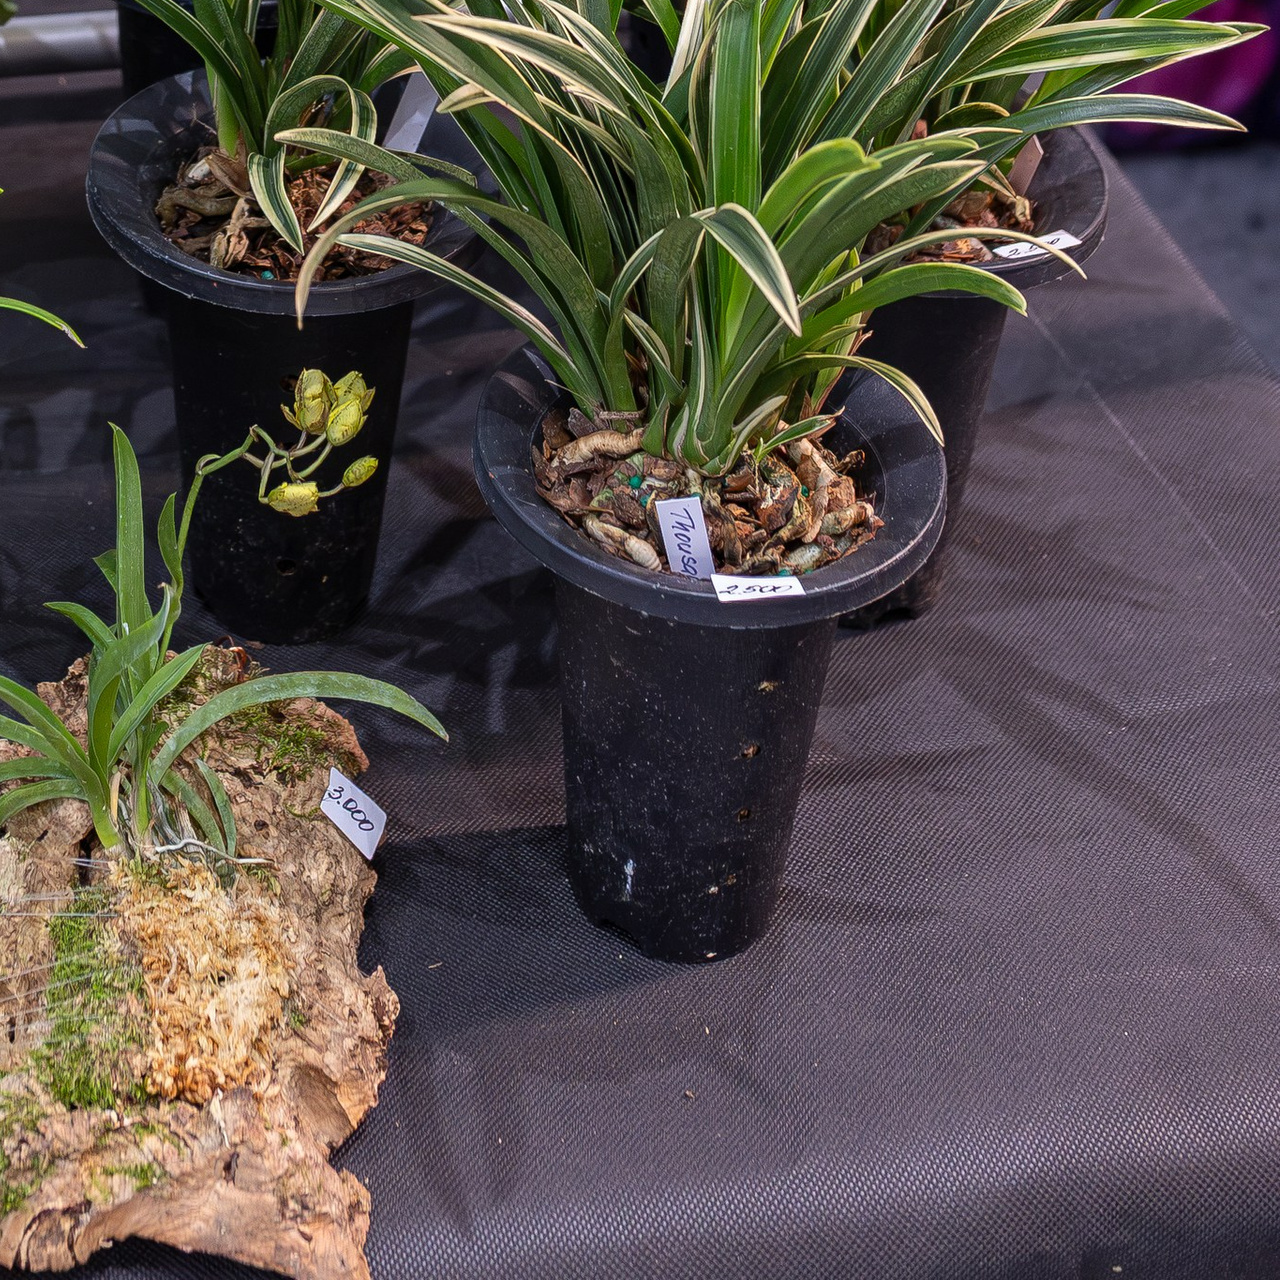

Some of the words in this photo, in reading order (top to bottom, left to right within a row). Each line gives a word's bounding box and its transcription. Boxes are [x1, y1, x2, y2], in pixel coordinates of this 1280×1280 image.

[670, 508, 699, 579] Thousa
[719, 584, 793, 595] 2.500
[328, 786, 375, 831] 3.000
